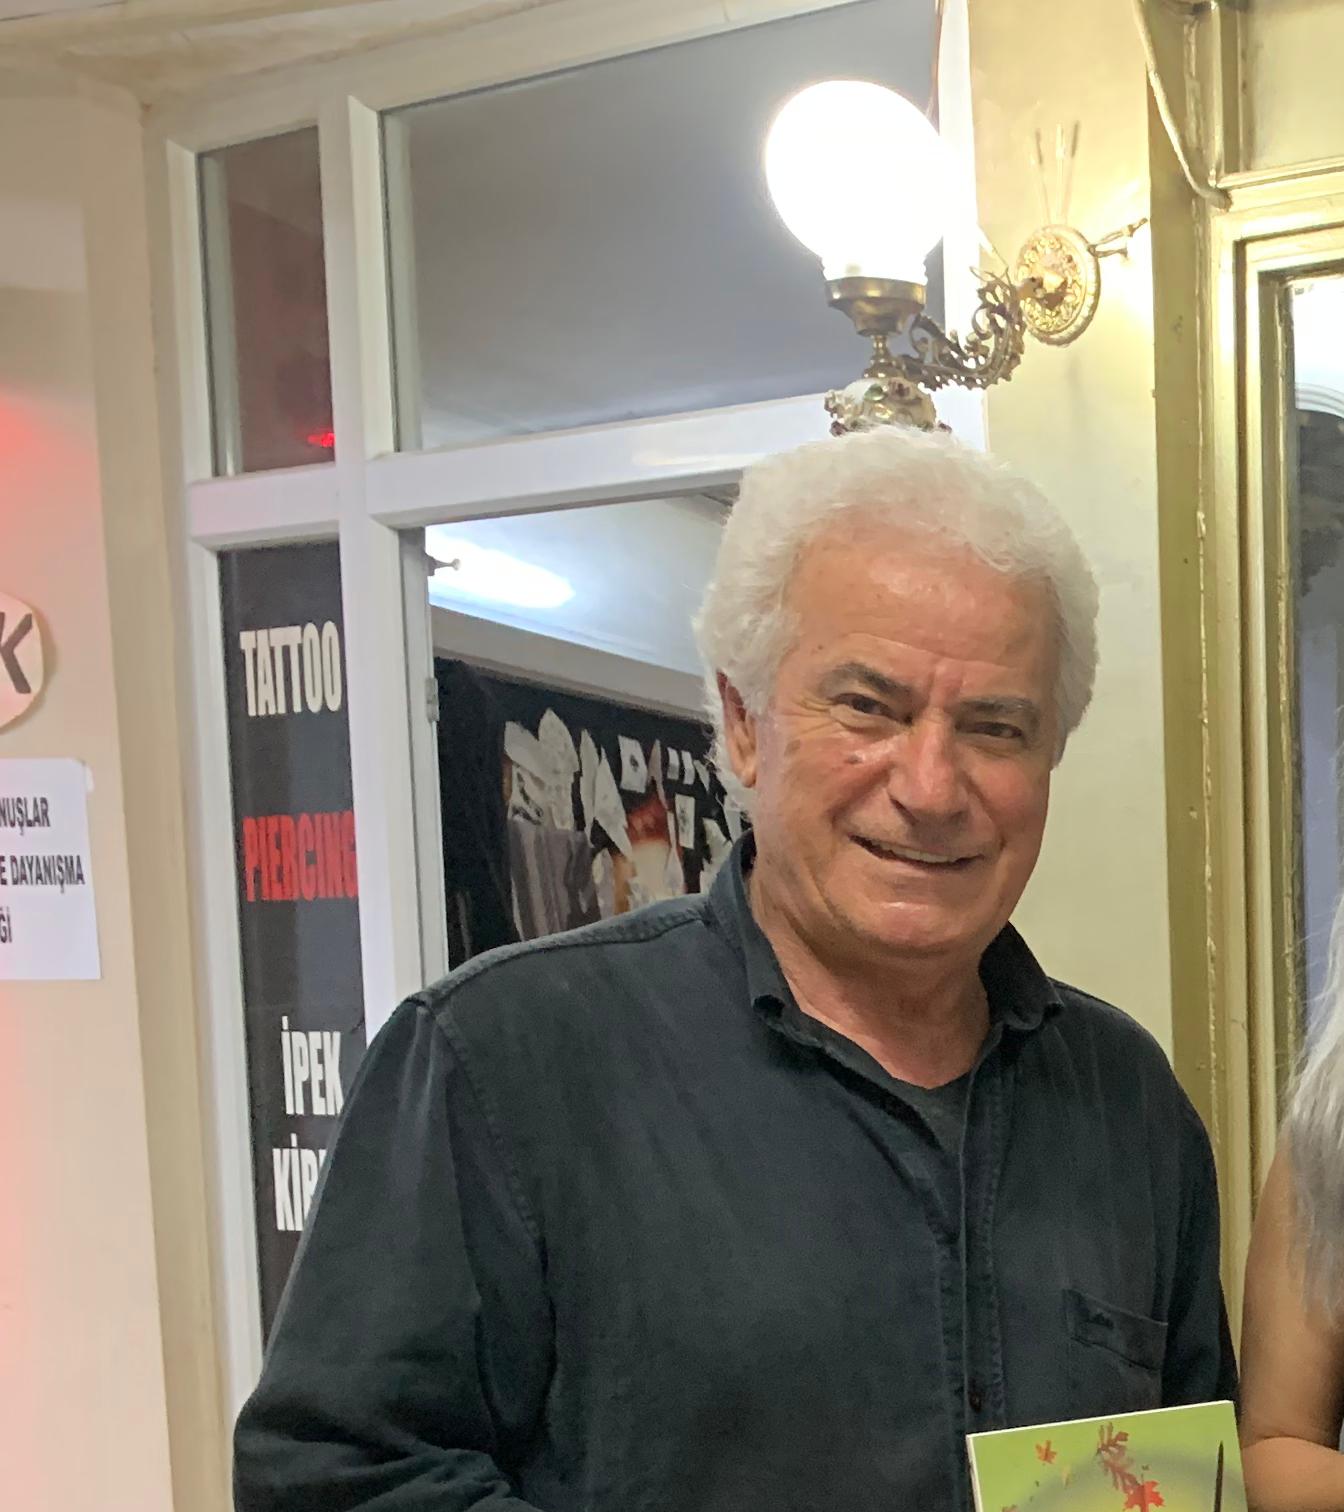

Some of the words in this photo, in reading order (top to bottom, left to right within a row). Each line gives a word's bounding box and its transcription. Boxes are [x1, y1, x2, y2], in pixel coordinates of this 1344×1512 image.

[240, 621, 342, 716] TATTOO
[10, 855, 86, 894] DAYANIŞMA
[281, 1016, 344, 1116] İPEK
